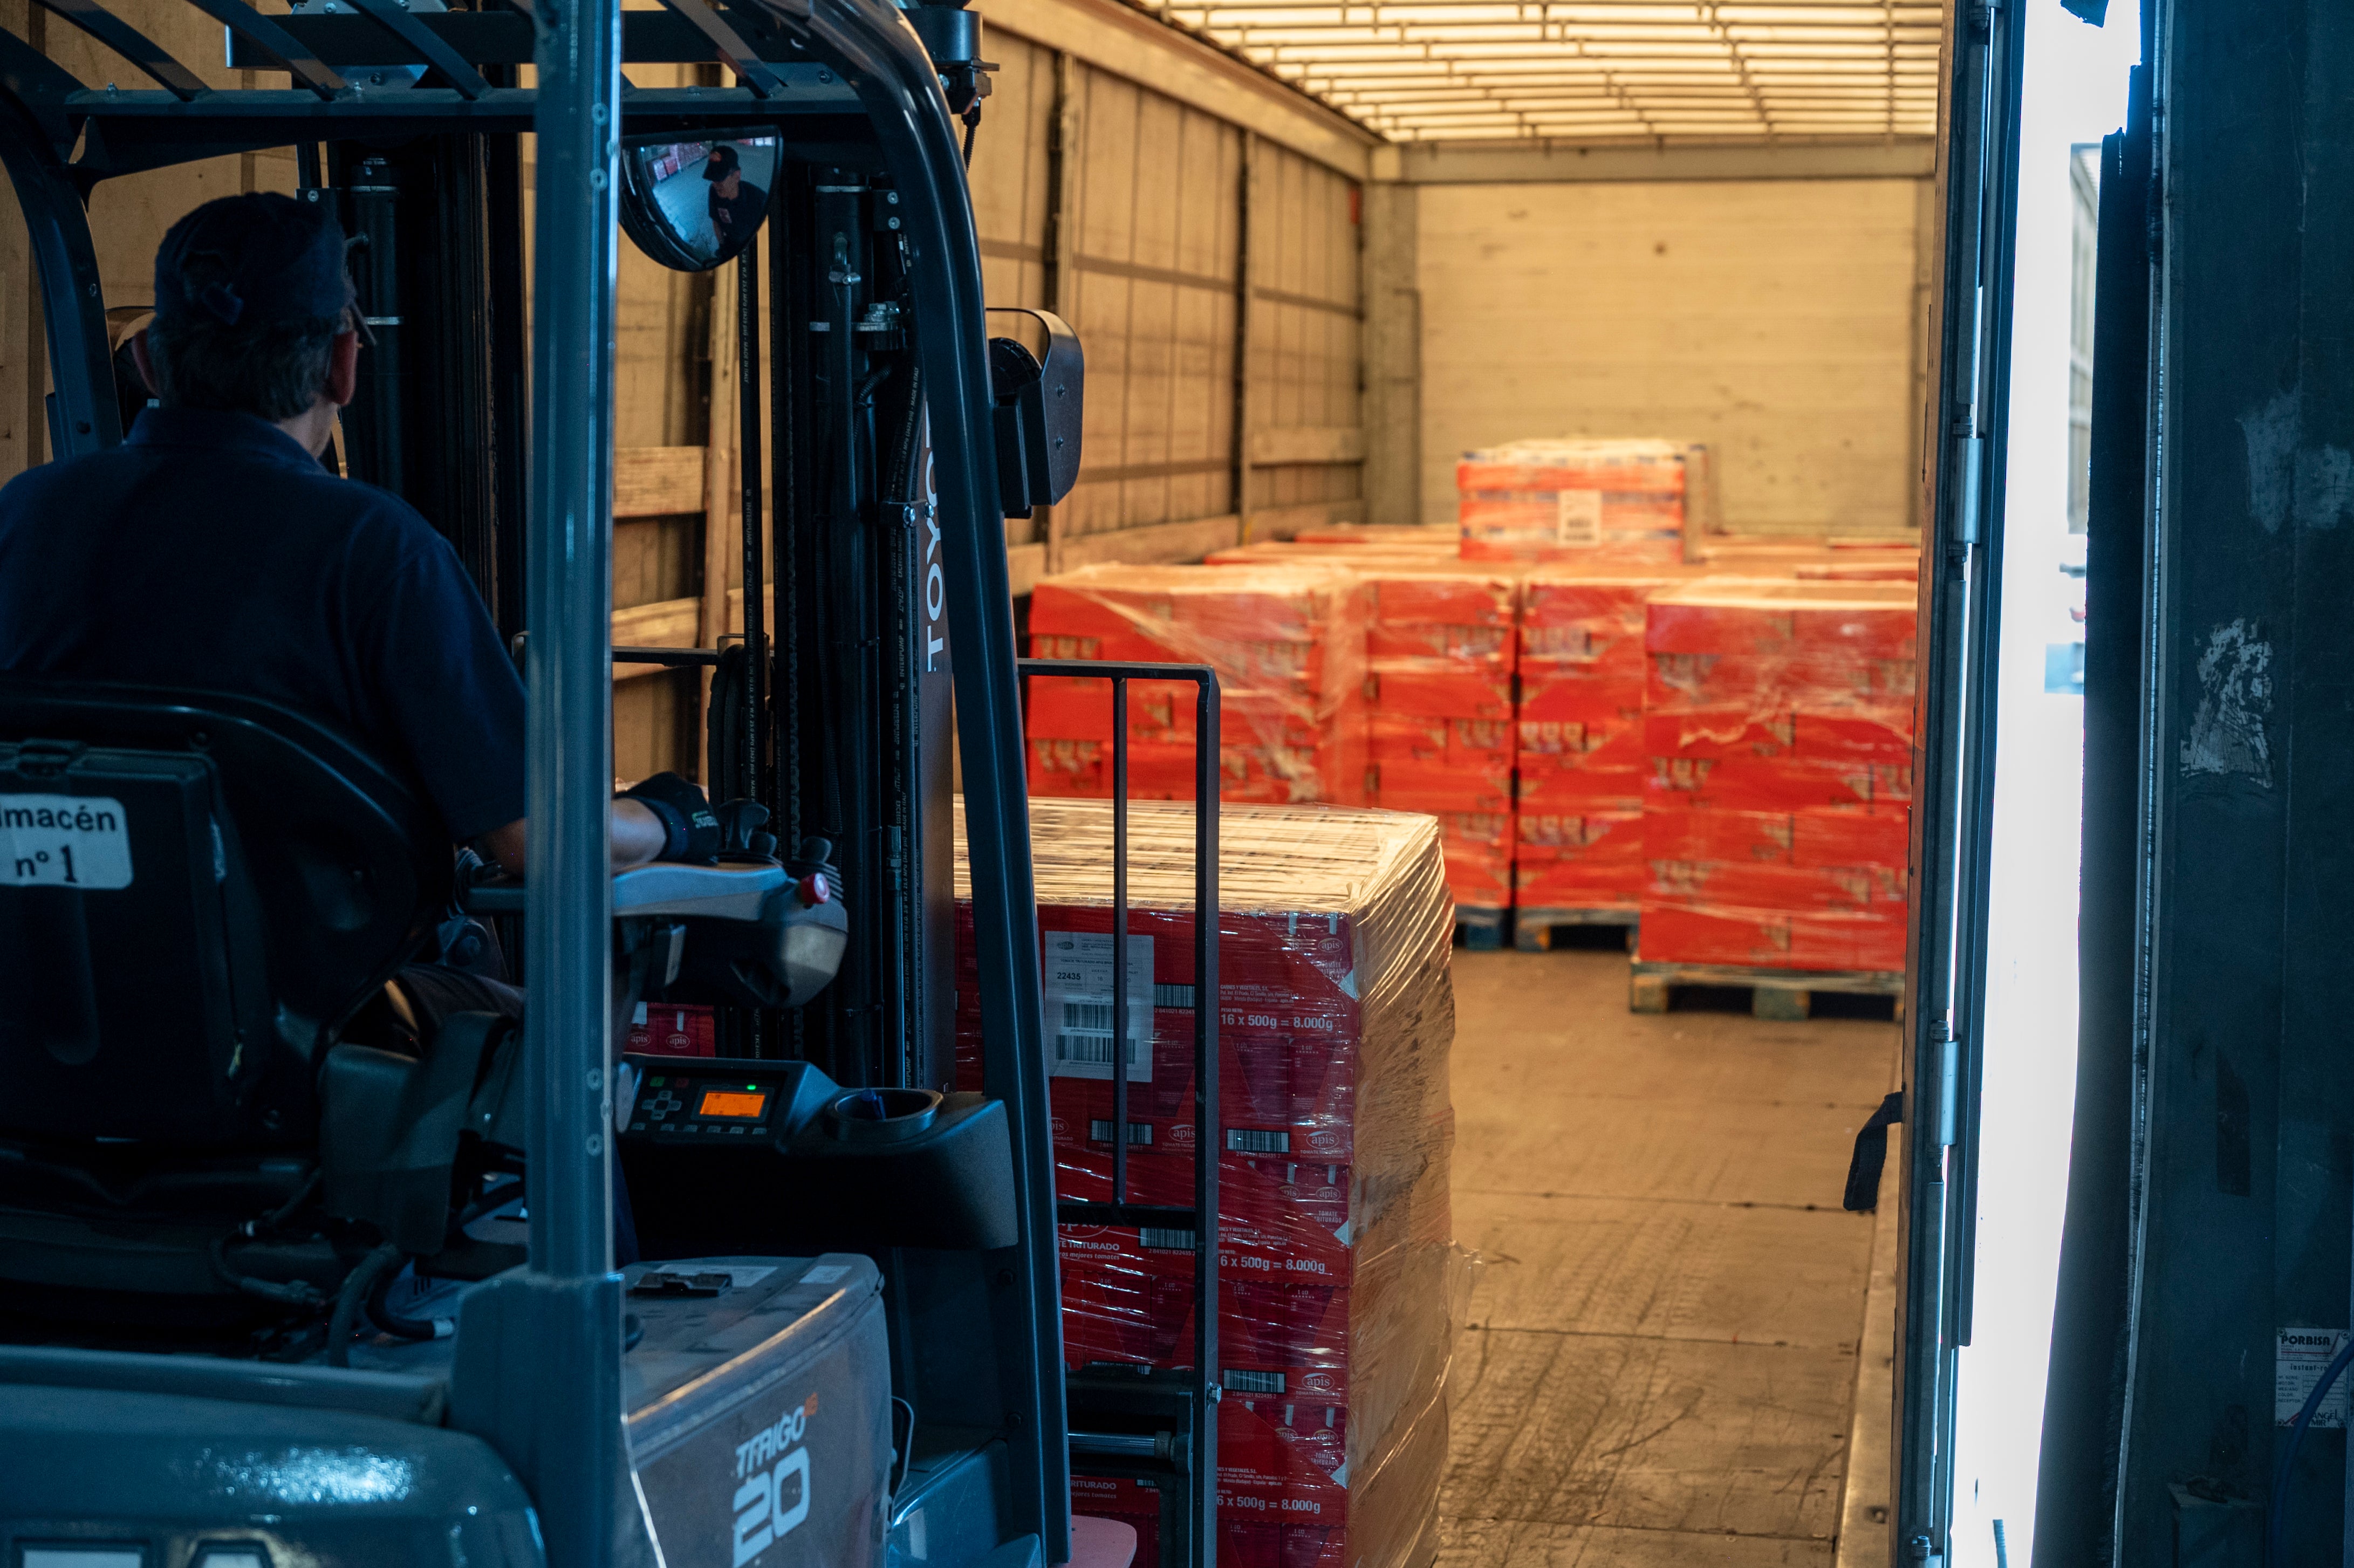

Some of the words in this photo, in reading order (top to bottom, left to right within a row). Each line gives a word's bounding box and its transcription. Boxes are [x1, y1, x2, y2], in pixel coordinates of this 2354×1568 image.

[59, 843, 78, 883] 1
[1321, 941, 1340, 950] apis
[1057, 972, 1081, 980] 22435
[1221, 1014, 1235, 1024] 16
[1237, 1017, 1245, 1025] x
[1248, 1015, 1277, 1029] 500g
[1293, 1017, 1333, 1031] 8.000g
[631, 1035, 648, 1045] apis
[669, 1036, 687, 1047] apis
[1173, 1127, 1195, 1140] apis
[1311, 1134, 1335, 1147] apis
[1319, 1189, 1338, 1199] apis
[1070, 1251, 1093, 1259] mejores
[1230, 1258, 1238, 1268] x
[1241, 1256, 1270, 1271] 500g
[1285, 1258, 1325, 1274] 8.000g
[2281, 1336, 2330, 1346] PORBISA
[2290, 1363, 2328, 1371] instant-ro
[1306, 1376, 1330, 1387] apis
[1317, 1432, 1335, 1441] apis
[1071, 1480, 1117, 1490] RITURADO
[1071, 1490, 1090, 1498] ejores
[733, 1444, 811, 1568] 20
[1227, 1498, 1234, 1507] x
[1236, 1497, 1265, 1510] 500g
[1282, 1499, 1320, 1514] 8.000g
